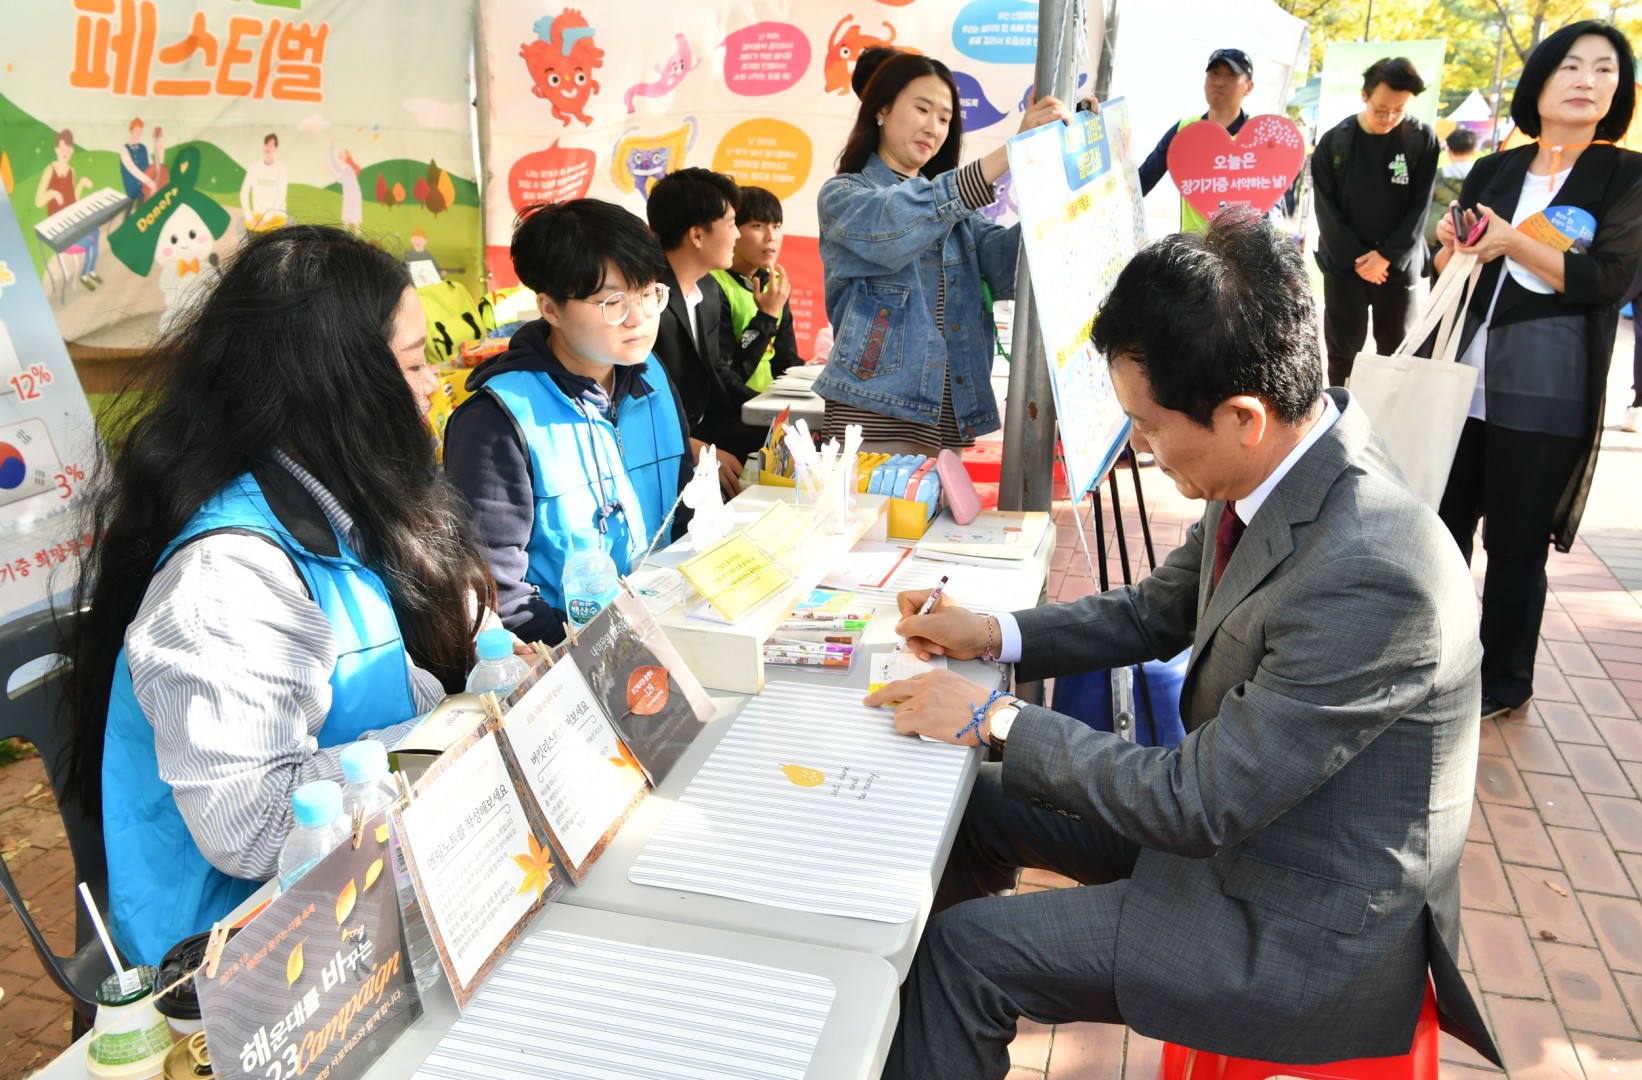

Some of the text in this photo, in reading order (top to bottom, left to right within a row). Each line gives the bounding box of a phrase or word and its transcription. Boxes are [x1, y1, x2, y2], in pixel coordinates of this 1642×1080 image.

[70, 0, 329, 103] 페스티벌
[1212, 151, 1256, 170] 오늘은
[1181, 174, 1287, 195] 장기기증 서약하는 날!
[10, 364, 51, 401] 12%
[53, 463, 85, 500] 3%
[571, 605, 597, 616] 백산수
[642, 681, 656, 698] 129
[528, 722, 568, 769] 버킷리스트
[424, 822, 468, 874] 엔딩노트를
[463, 779, 510, 834] 작성해보세요
[239, 986, 321, 1073] 해운대를
[320, 939, 373, 993] 바꾸는
[258, 1043, 300, 1080] 23
[296, 950, 401, 1077] Campaign
[331, 1027, 366, 1069] 서포터즈와
